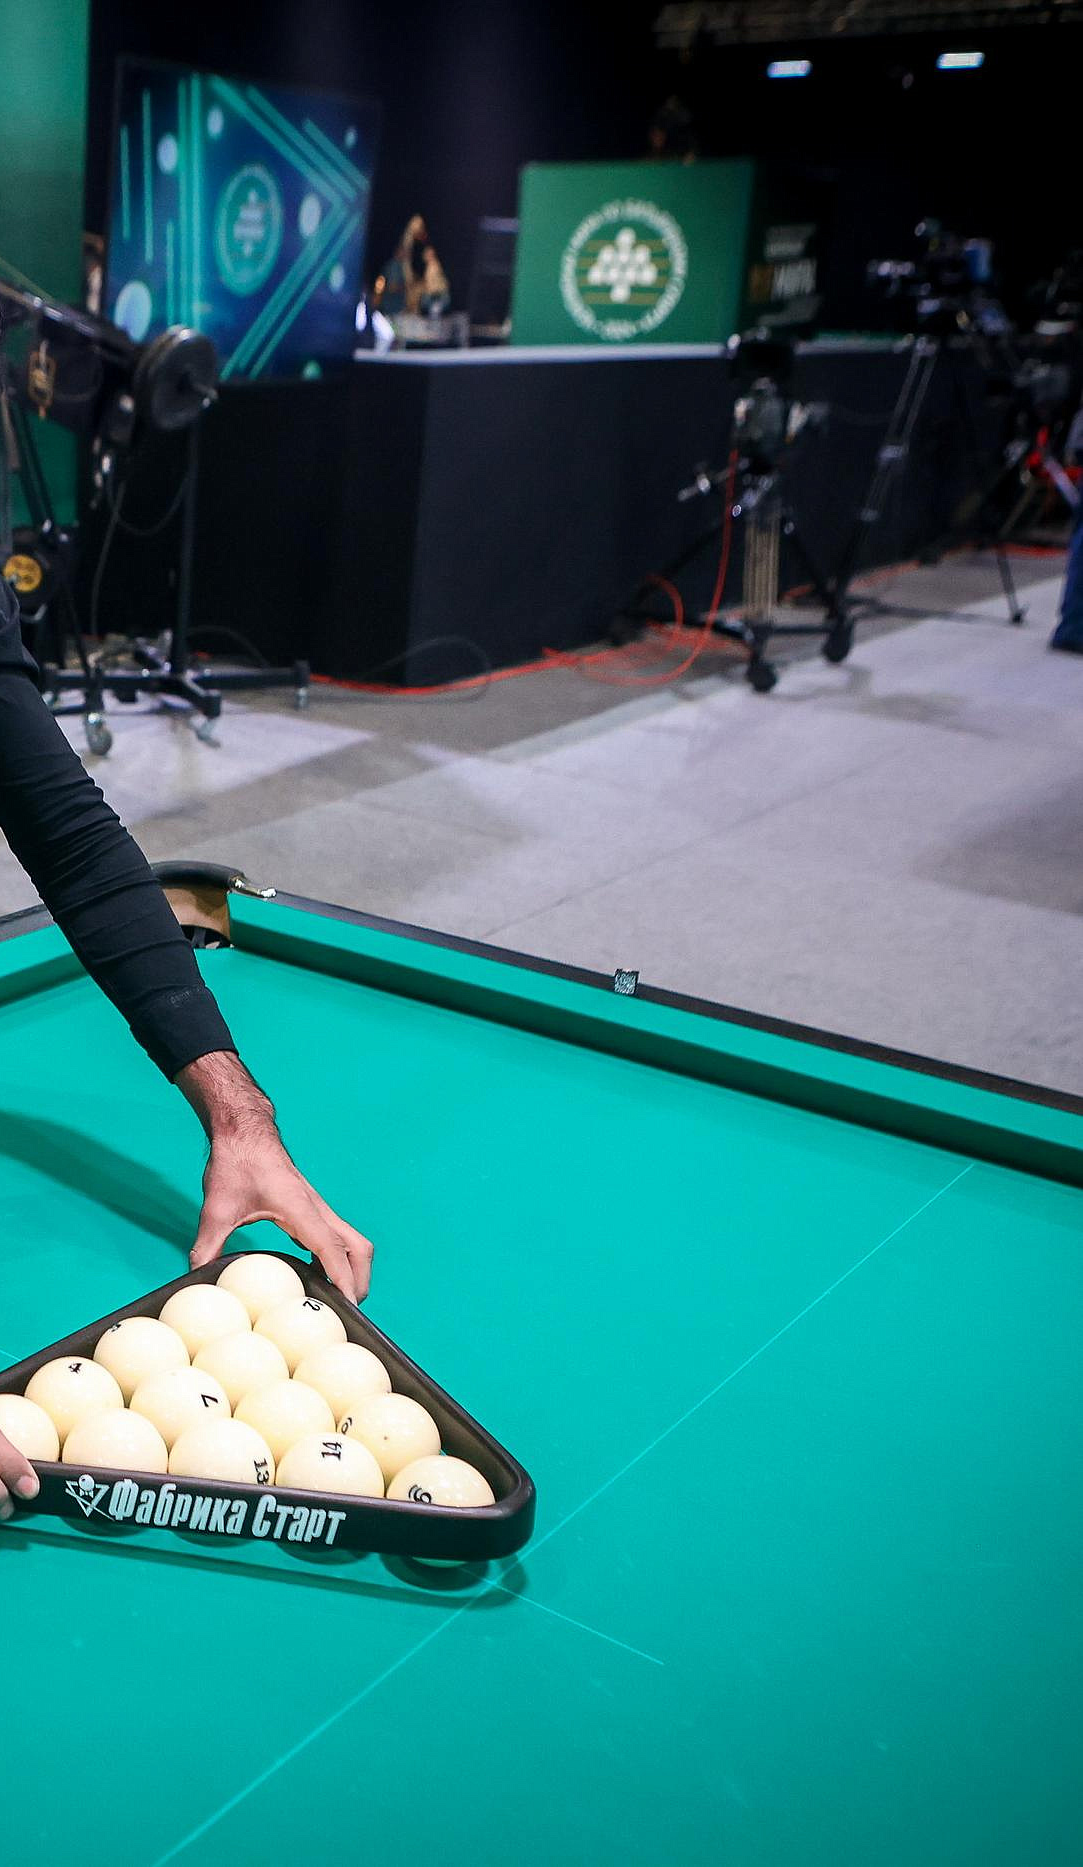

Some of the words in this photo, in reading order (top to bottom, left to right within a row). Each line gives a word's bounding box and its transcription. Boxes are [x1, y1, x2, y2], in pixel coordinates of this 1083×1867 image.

[68, 1362, 83, 1375] 4
[201, 1394, 219, 1408] 7
[321, 1441, 343, 1461] 14
[253, 1457, 270, 1486] 13
[108, 1478, 248, 1535] Фабрика
[251, 1494, 347, 1545] Старт
